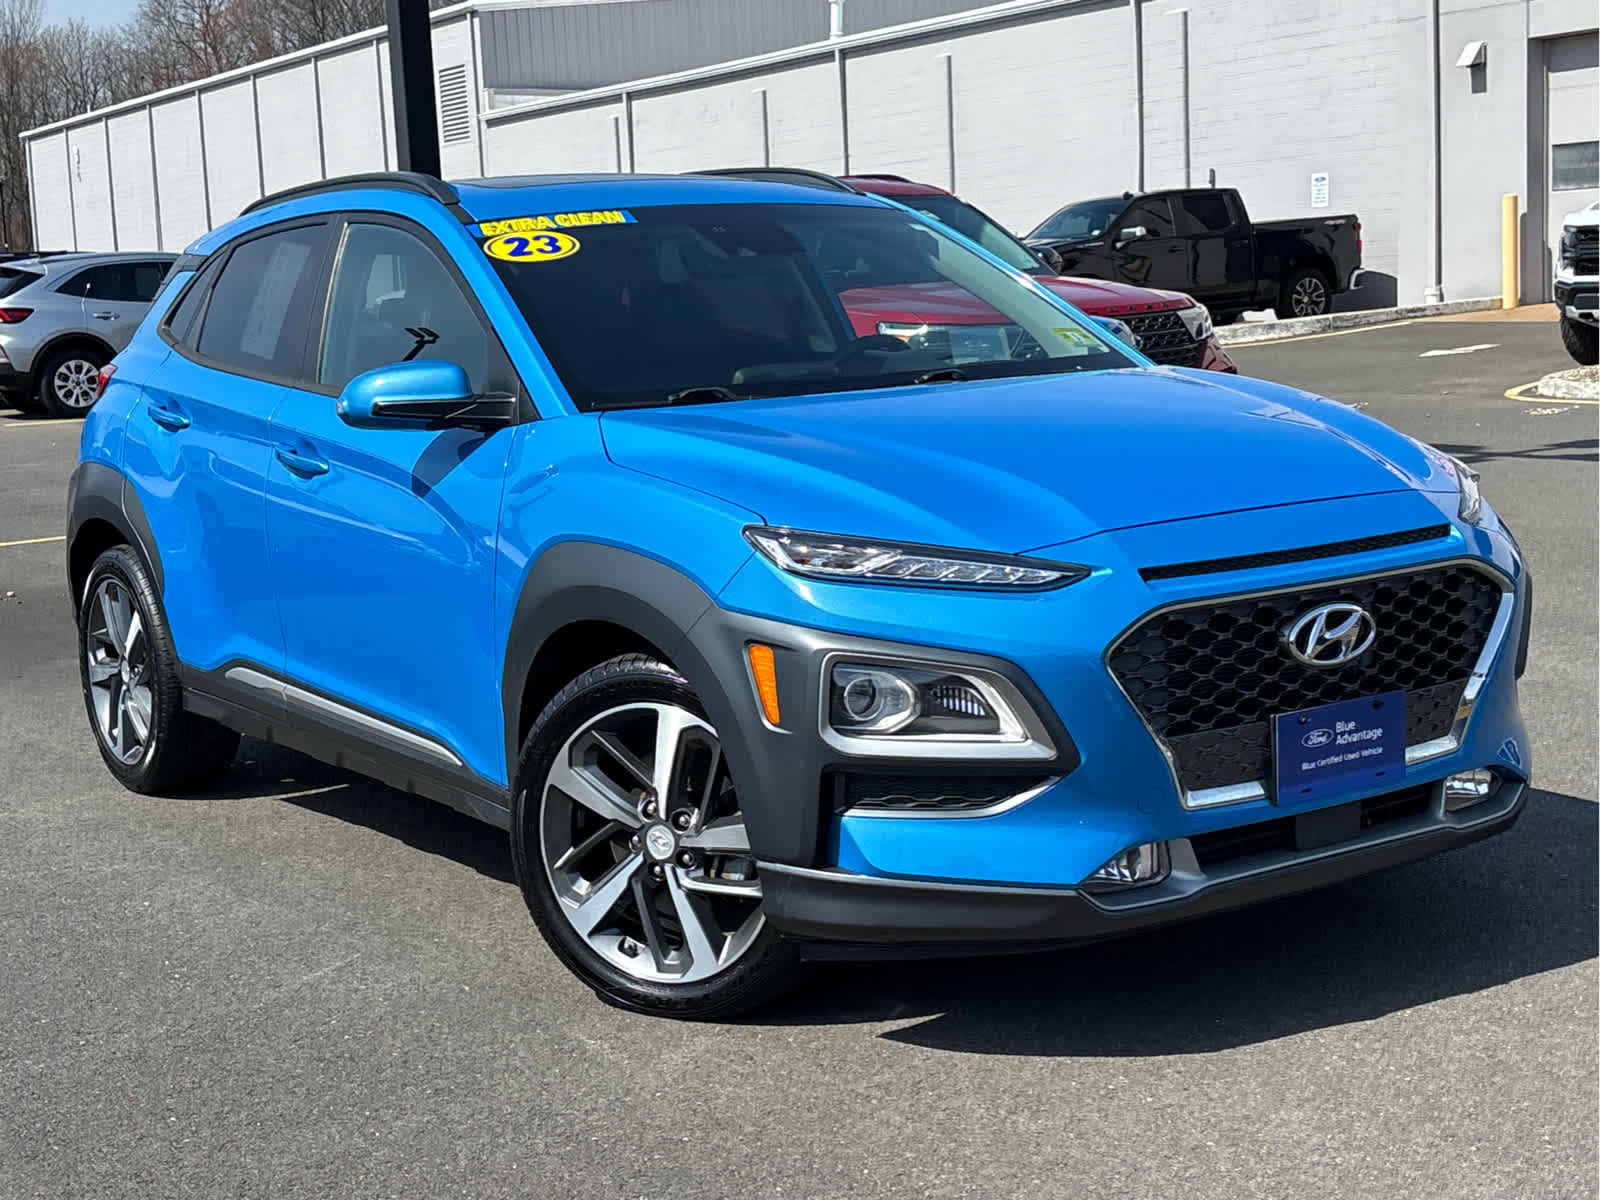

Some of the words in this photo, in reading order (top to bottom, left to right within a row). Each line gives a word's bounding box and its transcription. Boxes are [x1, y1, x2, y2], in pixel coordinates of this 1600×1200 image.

[480, 215, 557, 237] EXTRA
[503, 234, 562, 257] 23
[1335, 720, 1356, 733] Blue
[1335, 727, 1383, 745] Advantage
